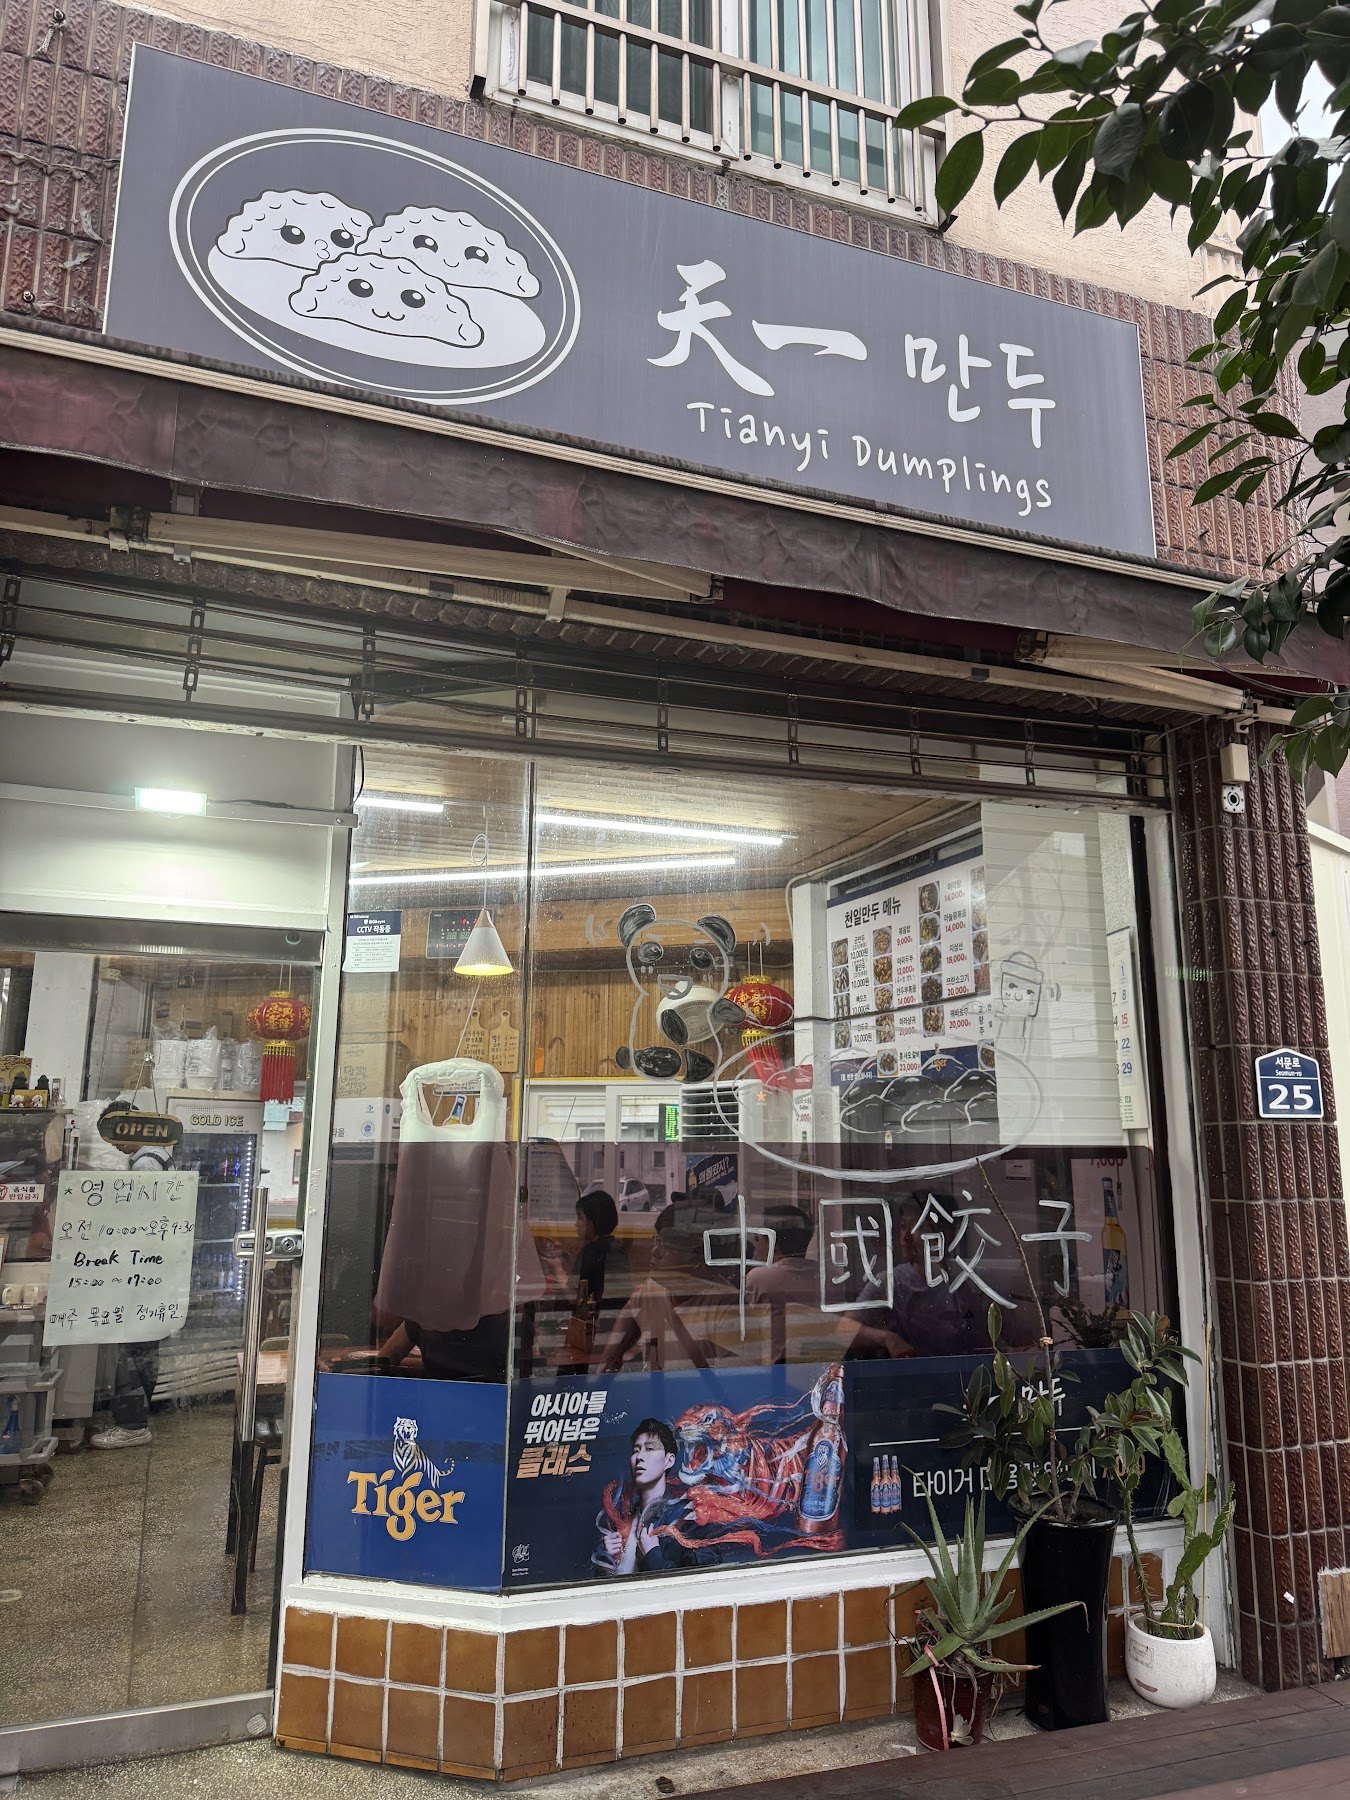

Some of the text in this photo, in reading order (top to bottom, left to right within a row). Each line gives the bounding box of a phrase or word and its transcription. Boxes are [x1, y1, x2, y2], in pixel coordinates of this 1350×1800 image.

[648, 259, 1056, 449] 天一 만두
[686, 401, 1053, 517] Tianyi Dumplings
[844, 897, 901, 928] 천일만두 메뉴
[373, 925, 391, 933] 작동중
[1121, 989, 1127, 1002] 8
[1120, 1013, 1129, 1026] 15
[1121, 1037, 1131, 1050] 22
[1122, 1062, 1133, 1076] 29
[1275, 1056, 1302, 1070] 서문로
[1267, 1084, 1314, 1110] 25
[115, 1121, 169, 1138] OPEN
[190, 1114, 245, 1127] GOLD ICE
[73, 1249, 164, 1267] Break Time
[703, 1190, 1093, 1342] 中國餃子
[127, 1274, 163, 1286] 17:00
[531, 1391, 607, 1417] 아시아를
[524, 1417, 600, 1444] 뛰어넘은
[516, 1443, 591, 1479] 클래스
[912, 1467, 974, 1497] 타이거
[347, 1469, 466, 1541] Tiger
